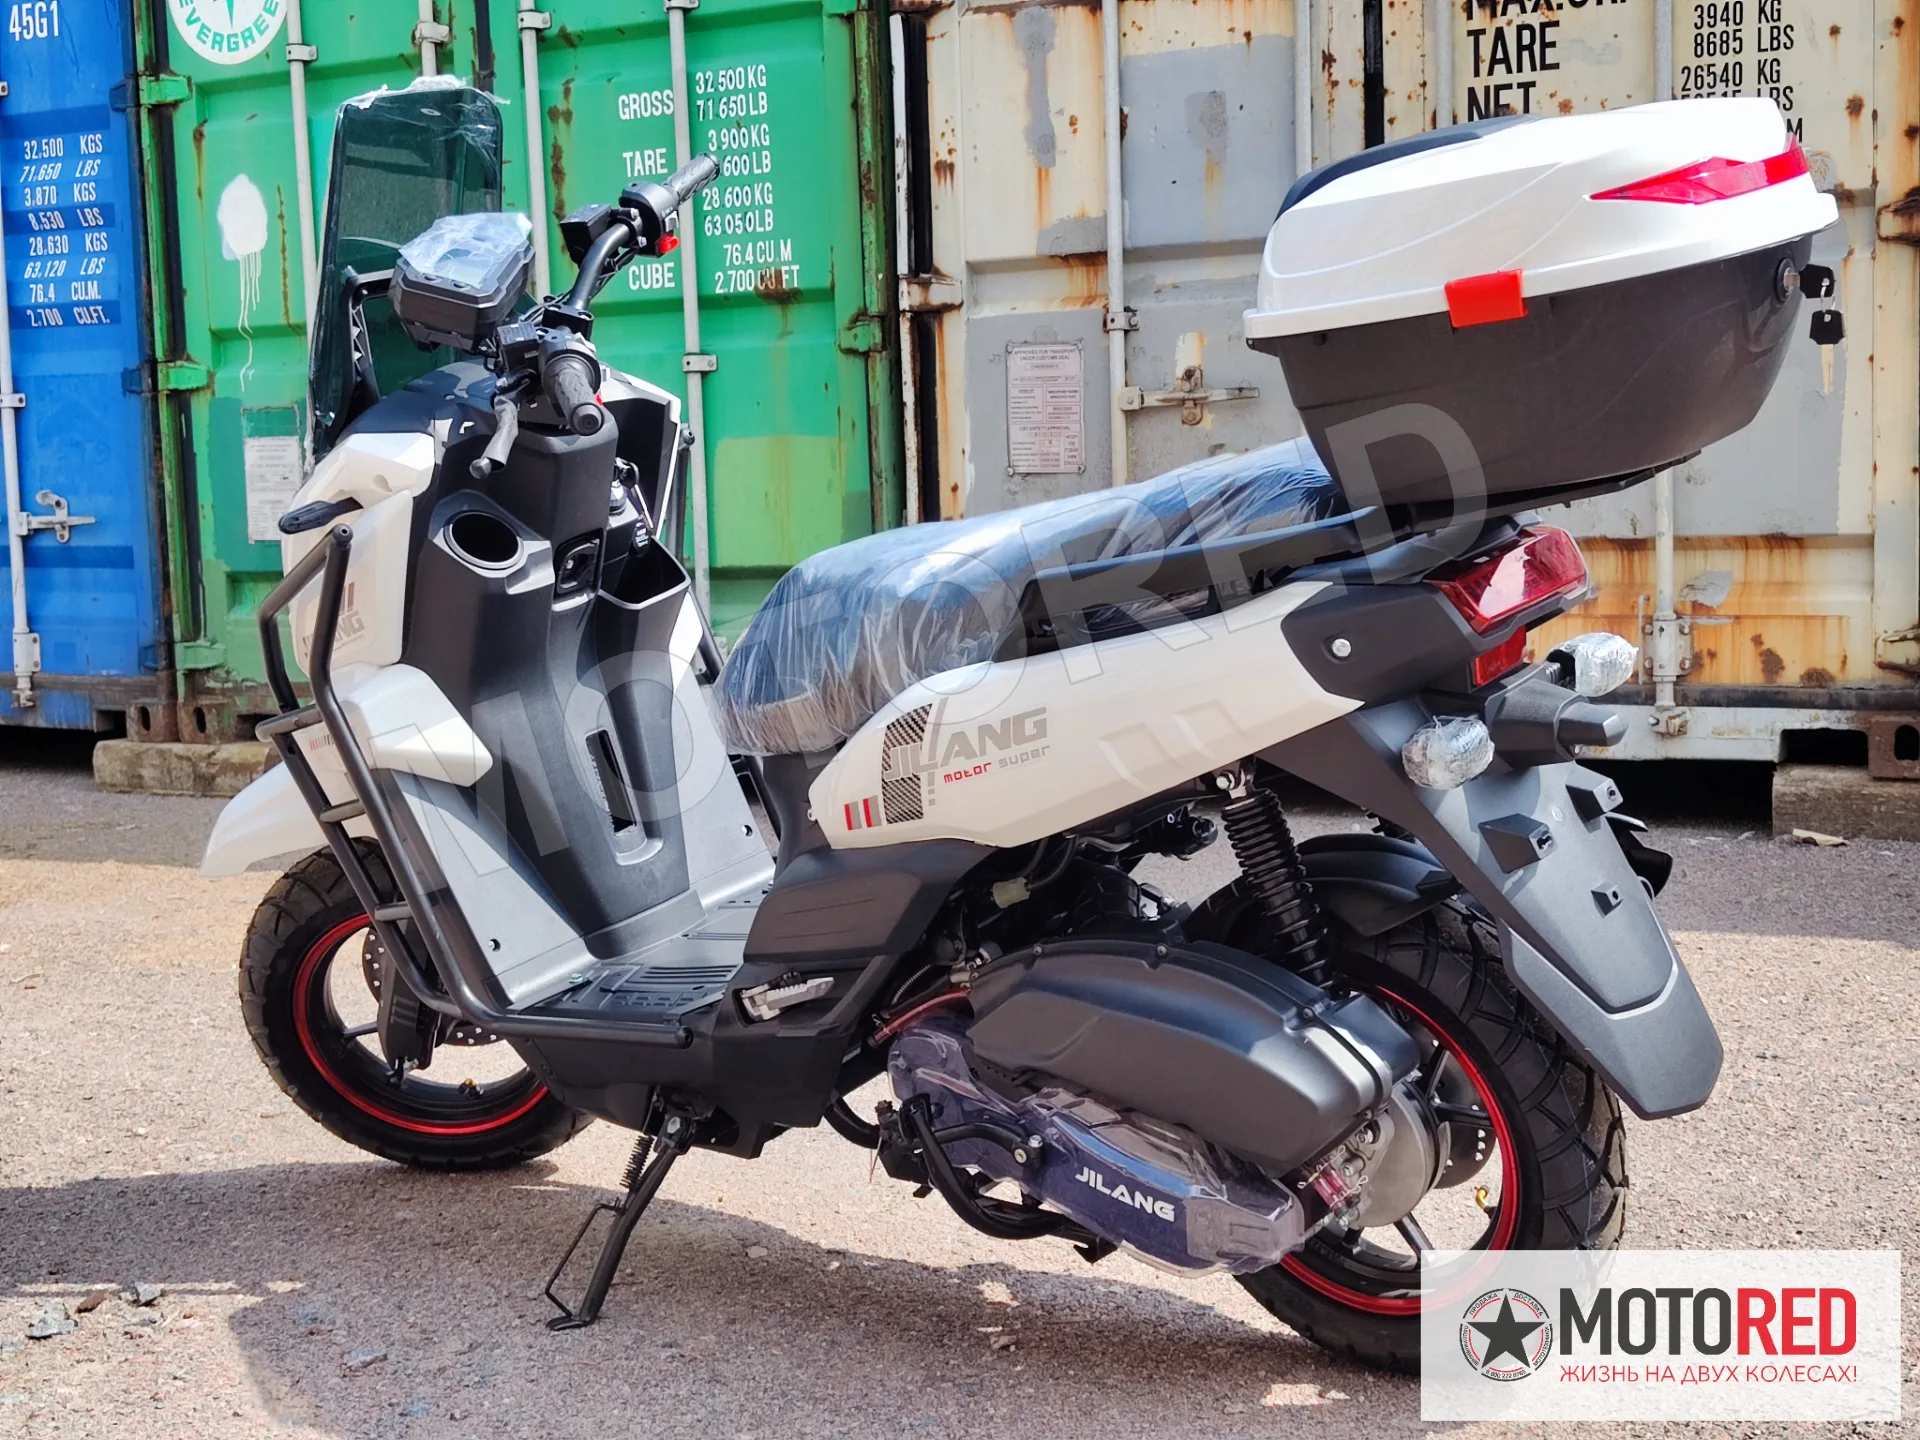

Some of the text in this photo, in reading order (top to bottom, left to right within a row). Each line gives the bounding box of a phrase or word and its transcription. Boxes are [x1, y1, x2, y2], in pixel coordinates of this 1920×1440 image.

[9, 0, 59, 41] 45G1
[1694, 0, 1781, 30] 3940 KG
[1467, 20, 1560, 78] TARE
[1694, 24, 1794, 58] 8685 LBS
[1681, 58, 1781, 92] 26540 KG
[618, 89, 674, 120] GROSS
[1467, 81, 1536, 122] NET
[80, 133, 103, 155] KGS
[75, 159, 101, 177] LBS
[622, 148, 668, 178] TARE
[73, 181, 96, 203] KGS
[76, 207, 104, 227] LBS
[85, 232, 108, 253] KGS
[80, 257, 106, 276] LBS
[629, 262, 675, 290] CUBE
[884, 707, 1047, 782] JILANG
[943, 745, 1051, 784] motor super
[1075, 1166, 1175, 1222] JILANG
